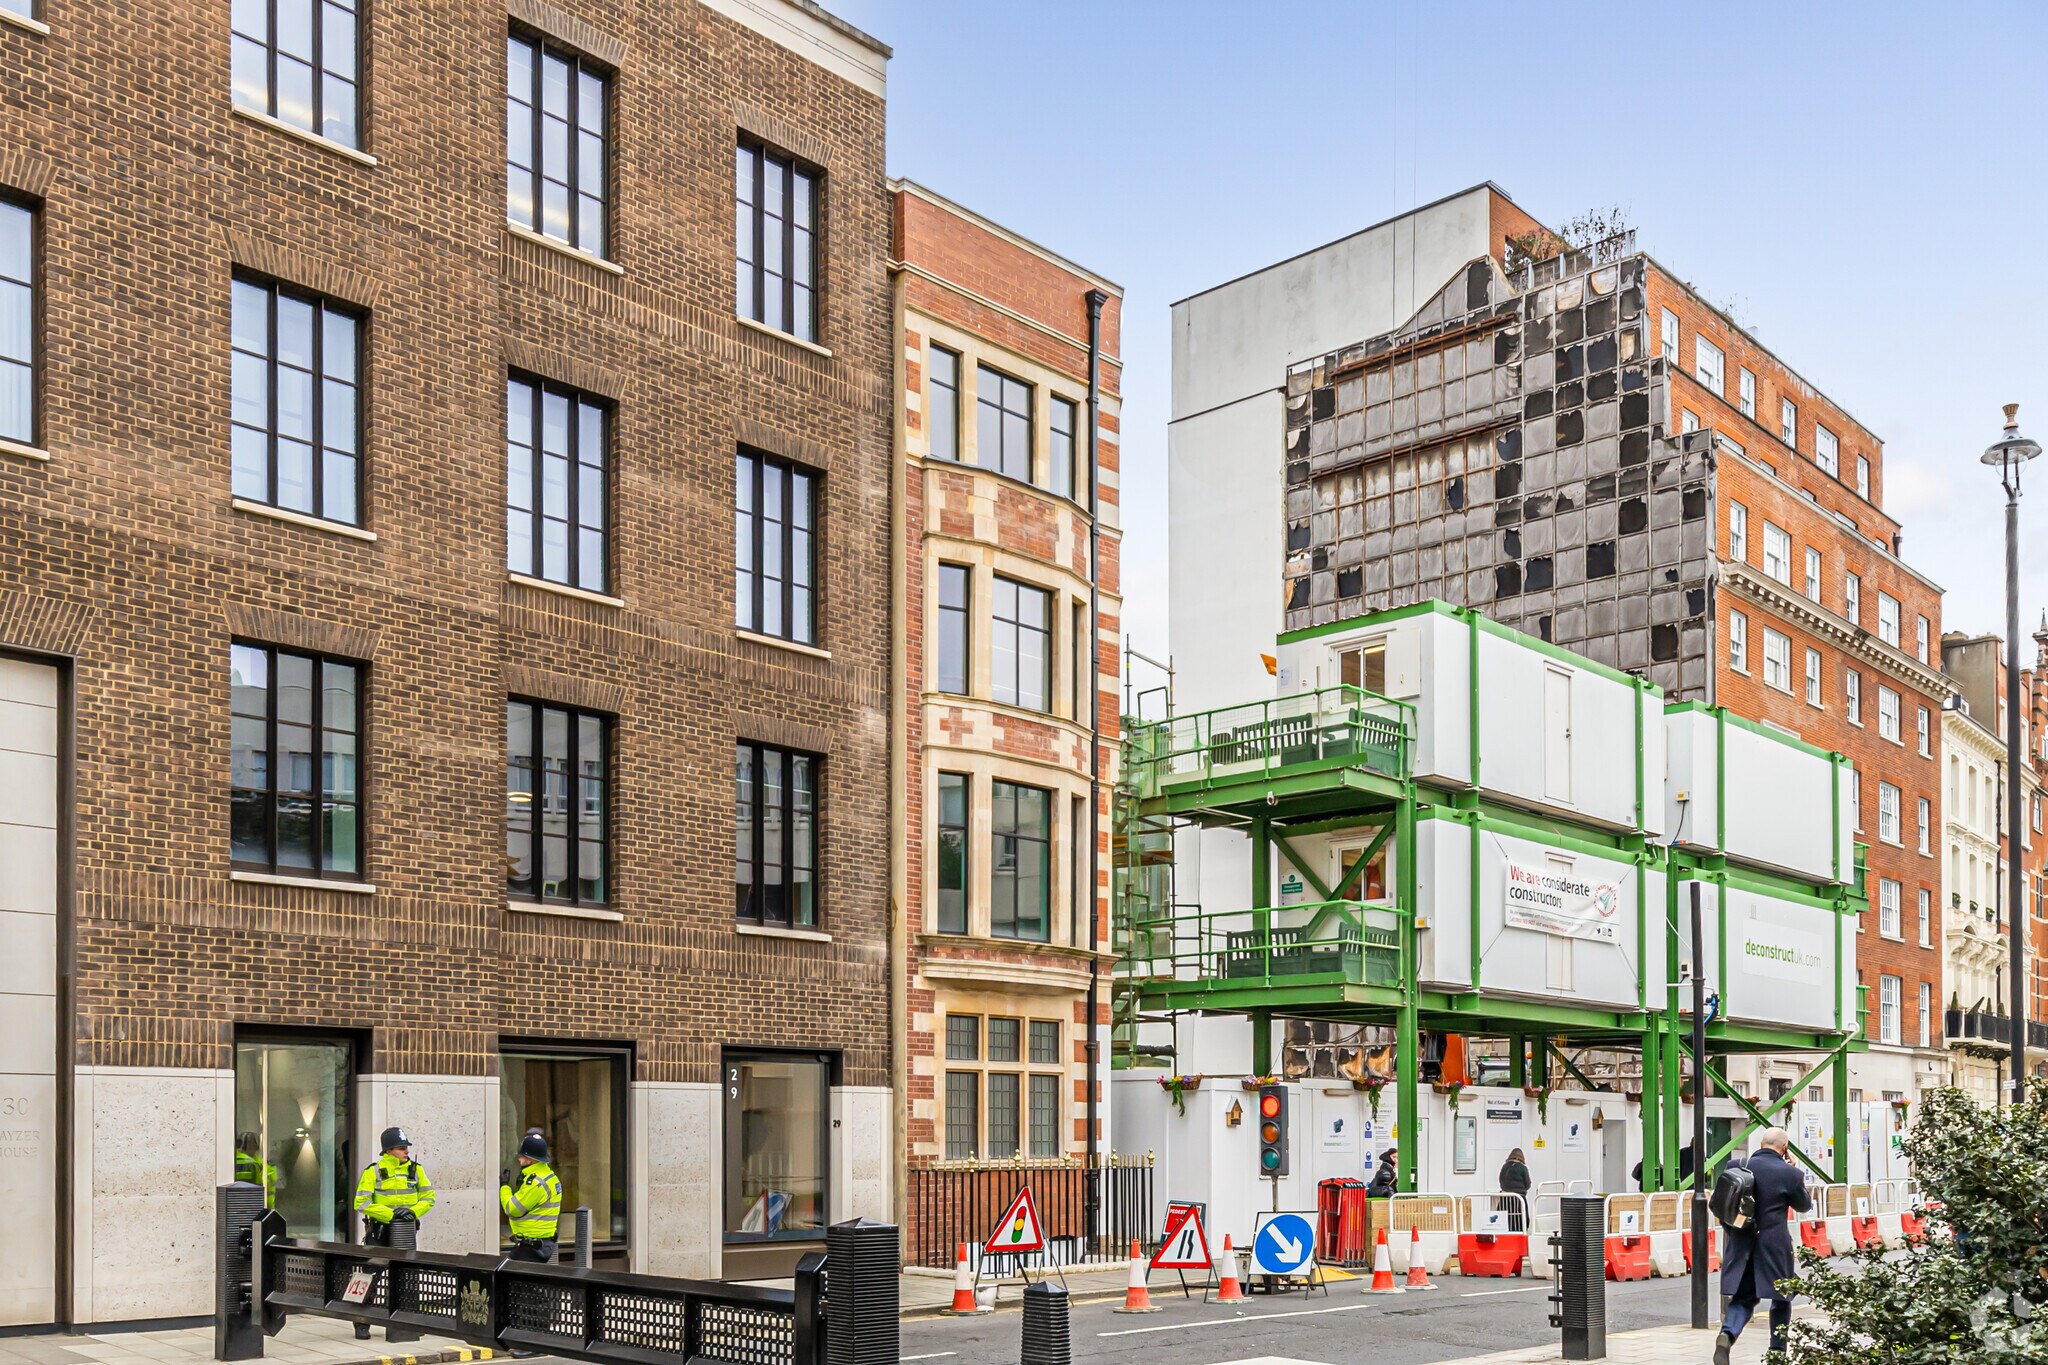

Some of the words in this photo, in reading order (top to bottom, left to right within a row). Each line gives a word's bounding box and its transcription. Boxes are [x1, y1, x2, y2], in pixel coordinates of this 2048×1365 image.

[1510, 865, 1524, 881] We
[1526, 872, 1541, 886] are
[1542, 876, 1590, 897] considerate
[1510, 886, 1562, 908] constructors
[1745, 938, 1821, 968] deconstructuk.com
[3, 1097, 29, 1115] 30
[832, 1120, 841, 1128] 29
[0, 1130, 41, 1141] AYZER
[0, 1146, 38, 1158] OUSE
